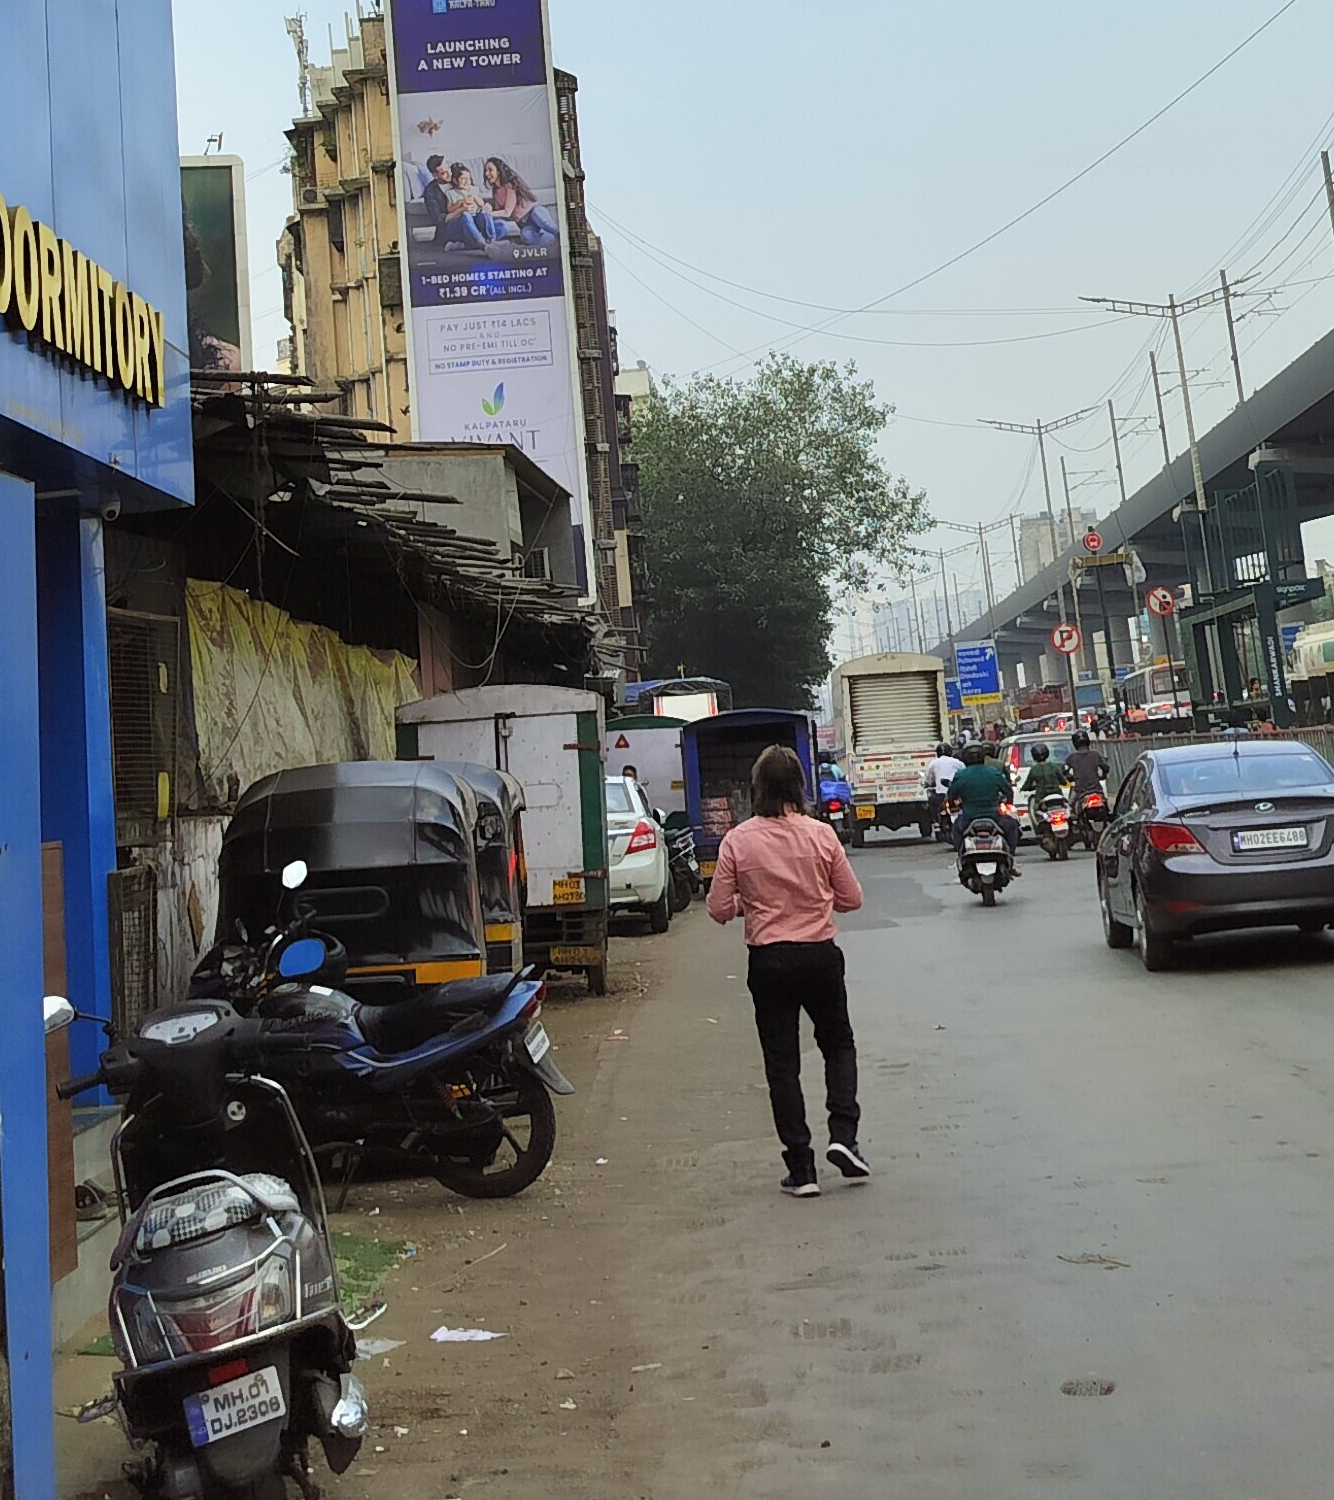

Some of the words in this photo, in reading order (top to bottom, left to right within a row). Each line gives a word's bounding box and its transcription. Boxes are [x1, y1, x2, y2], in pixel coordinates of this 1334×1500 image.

[427, 37, 510, 54] LAUNCHING
[417, 59, 429, 71] A
[433, 57, 465, 70] NEW
[470, 53, 521, 67] TOWER
[521, 247, 547, 258] JVLR
[421, 274, 450, 285] 1-BED
[451, 271, 486, 283] HOMES
[488, 268, 534, 280] STARTING
[535, 267, 548, 277] AT
[440, 323, 459, 332] PAY
[463, 320, 487, 331] JUST
[510, 317, 536, 328] LACS
[443, 344, 457, 353] NO
[447, 360, 470, 369] STAMP
[472, 359, 489, 367] DUTY
[464, 418, 527, 431] KALPATARU
[1266, 635, 1283, 697] SHANKARWADI
